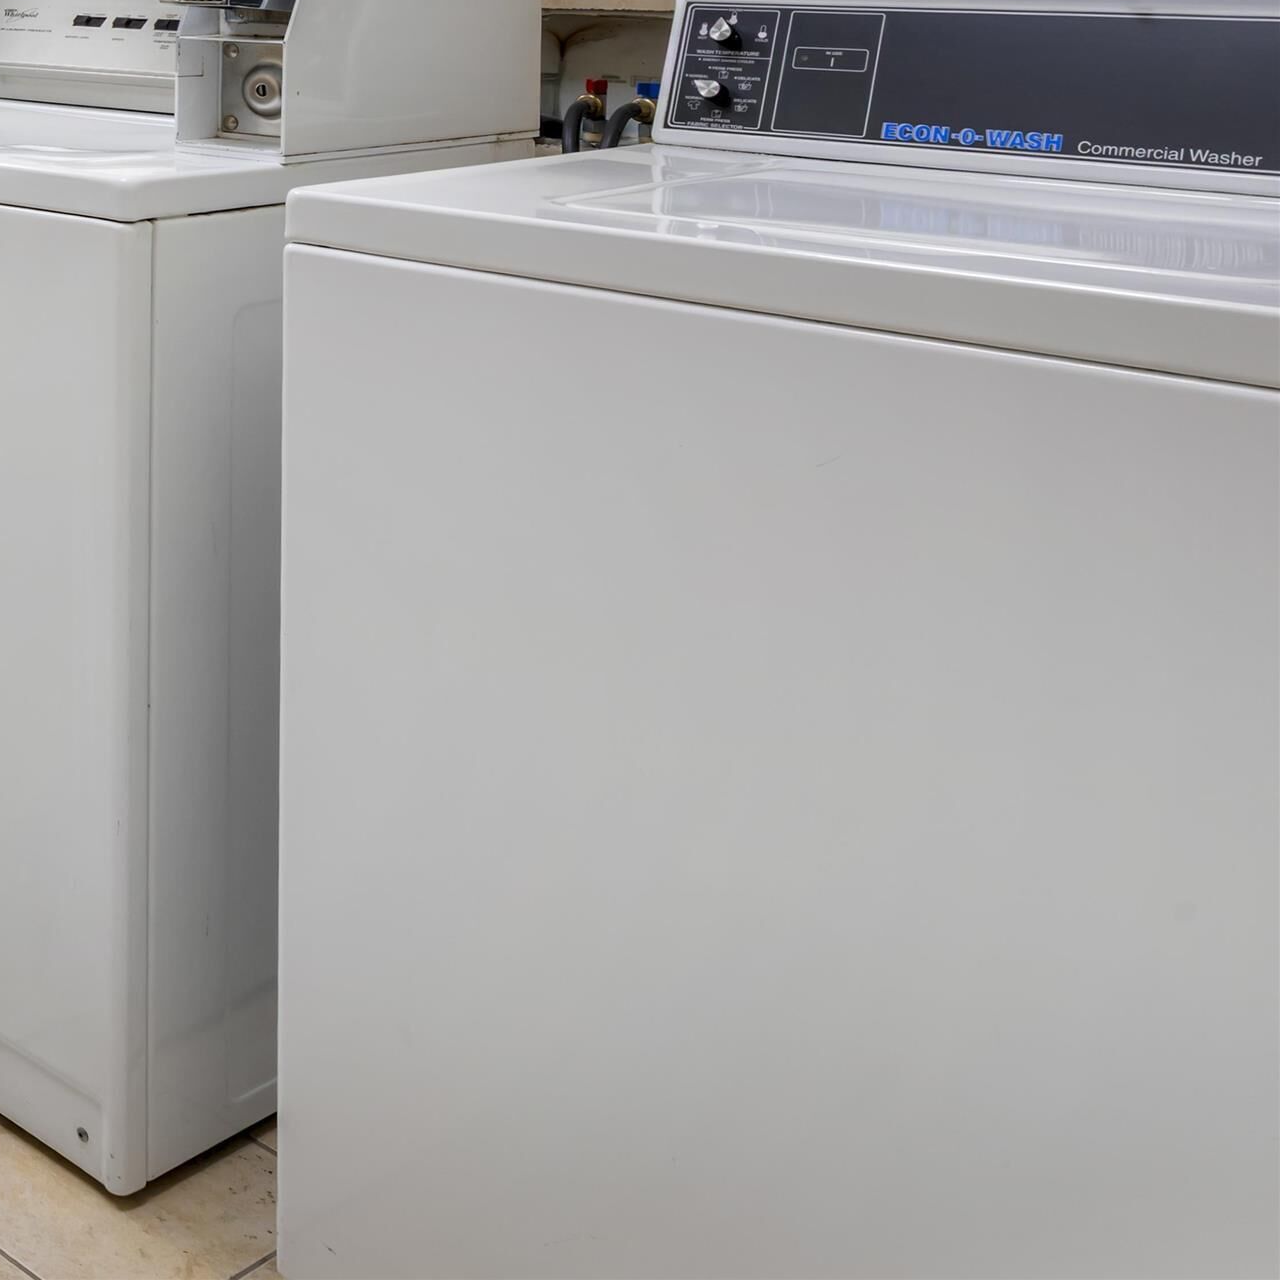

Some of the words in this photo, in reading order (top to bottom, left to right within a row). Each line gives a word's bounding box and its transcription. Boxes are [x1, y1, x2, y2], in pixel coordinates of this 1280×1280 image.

[880, 122, 1064, 152] ECON-O-WASH
[1077, 140, 1185, 161] Commercial
[1190, 148, 1263, 167] Washer
